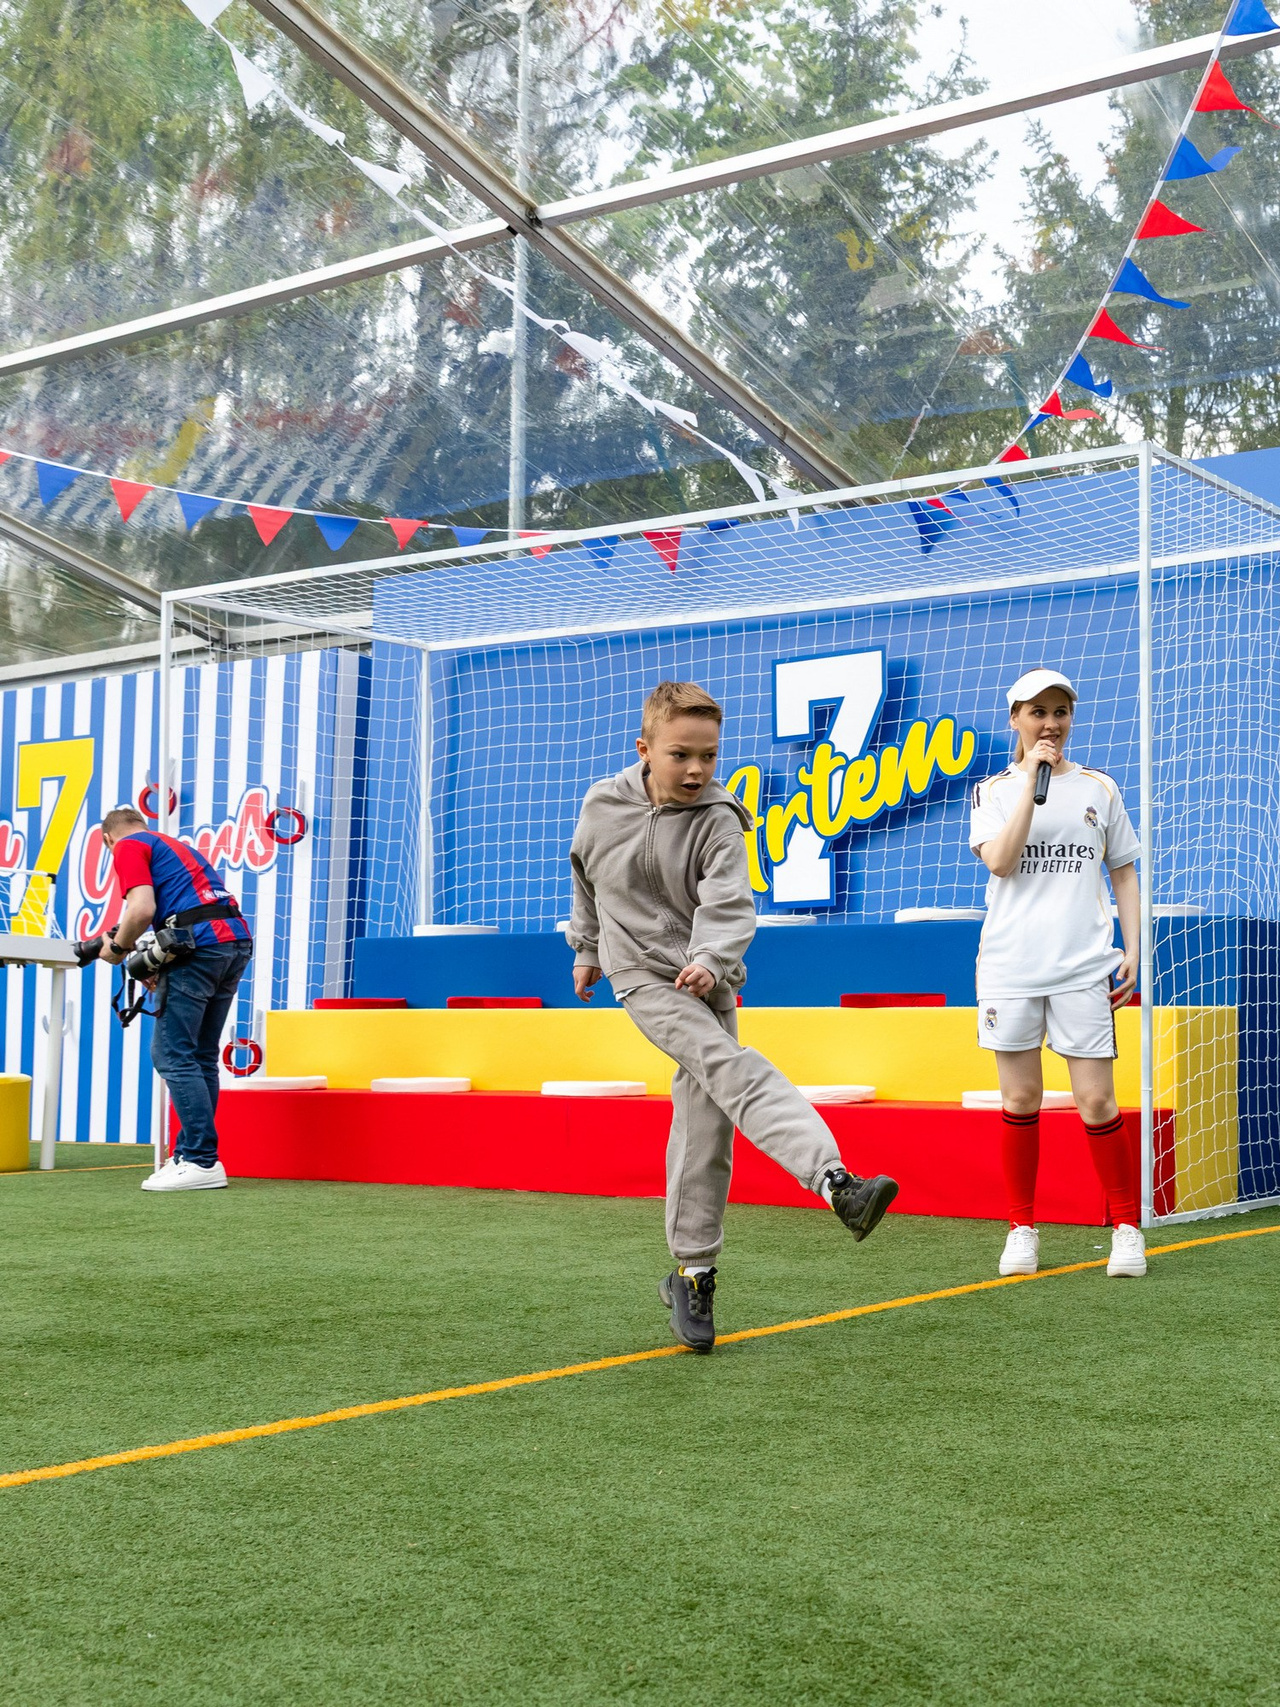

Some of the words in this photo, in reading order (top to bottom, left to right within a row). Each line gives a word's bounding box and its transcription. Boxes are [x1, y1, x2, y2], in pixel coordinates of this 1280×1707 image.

[11, 737, 95, 936] 7
[726, 716, 976, 893] Artem
[773, 650, 886, 903] 7
[1021, 841, 1095, 860] mirates
[1020, 861, 1039, 874] FLY
[1041, 860, 1083, 873] BETTER
